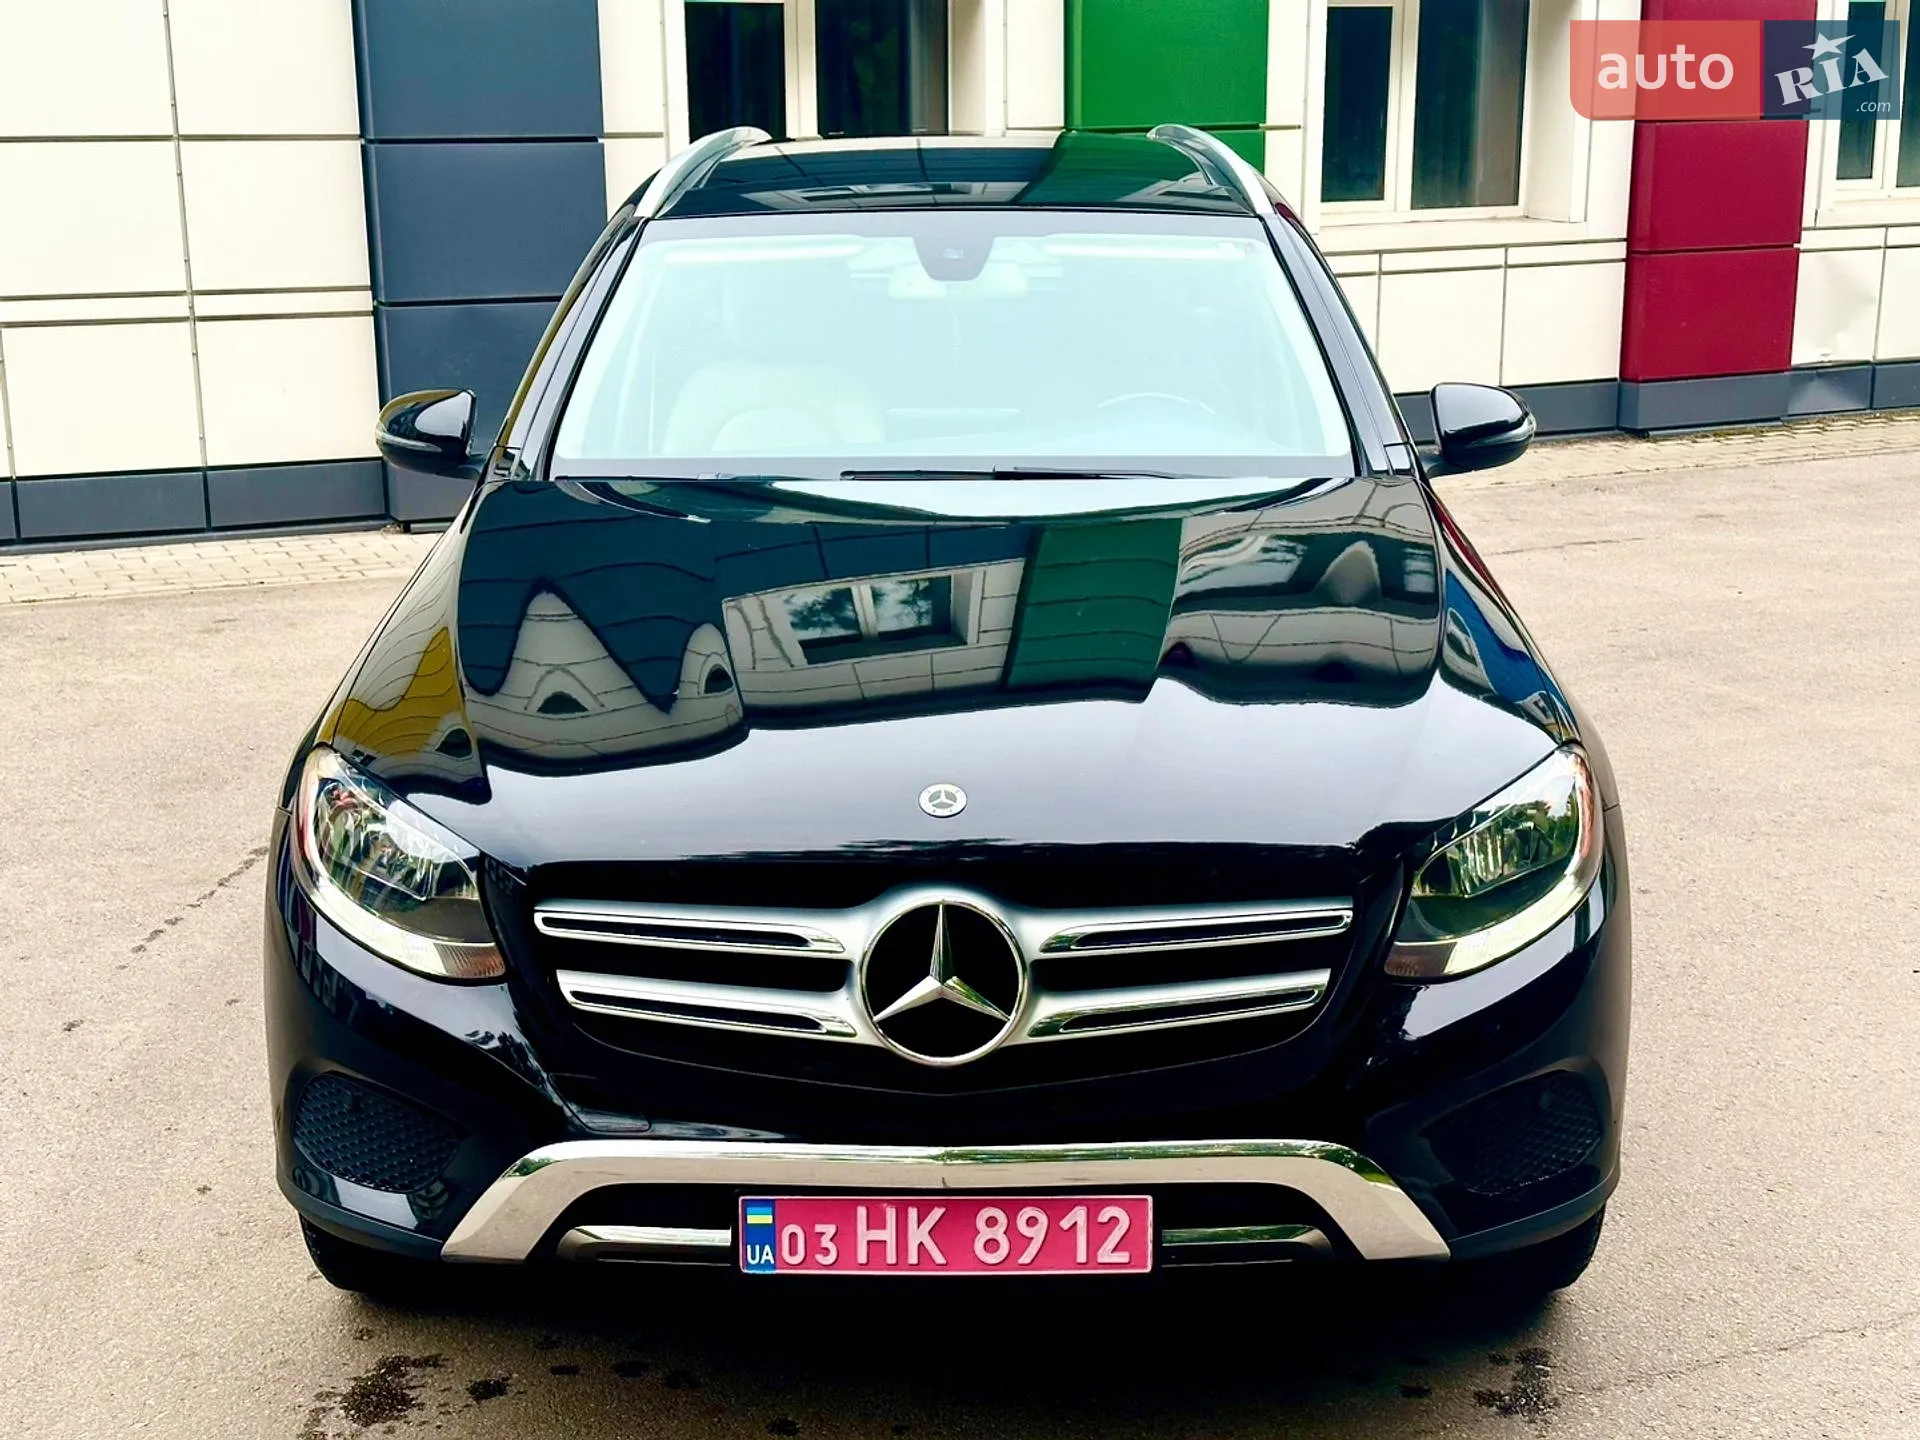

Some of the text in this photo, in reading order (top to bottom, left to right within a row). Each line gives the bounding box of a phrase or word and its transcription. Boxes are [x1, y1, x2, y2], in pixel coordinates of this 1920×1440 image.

[746, 1245, 775, 1265] UA
[781, 1205, 1131, 1266] 03 HK 8912
